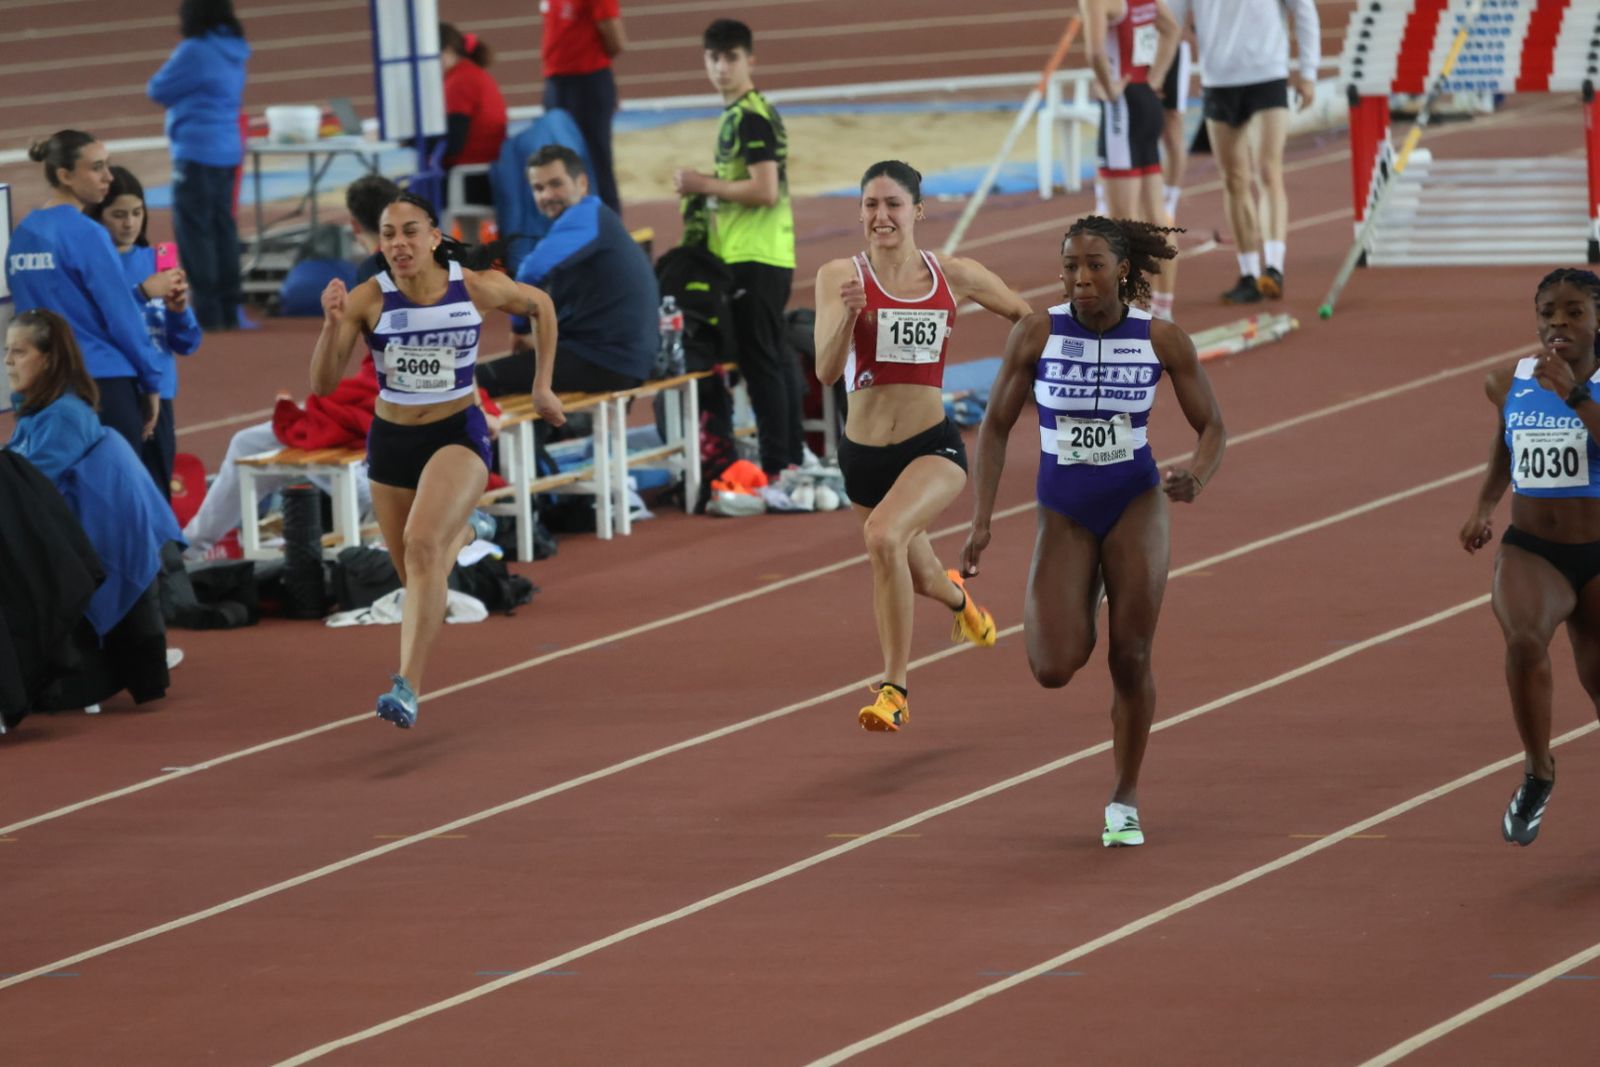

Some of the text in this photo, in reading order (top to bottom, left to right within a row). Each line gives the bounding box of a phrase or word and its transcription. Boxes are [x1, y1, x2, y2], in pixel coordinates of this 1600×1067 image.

[388, 329, 477, 348] RACING
[890, 321, 937, 345] 1563
[396, 358, 441, 376] 2600
[1044, 361, 1154, 384] RACING
[1048, 385, 1147, 401] VALLADOLID
[1508, 411, 1584, 429] Piélago
[1071, 423, 1116, 448] 2601
[1518, 446, 1579, 478] 4030
